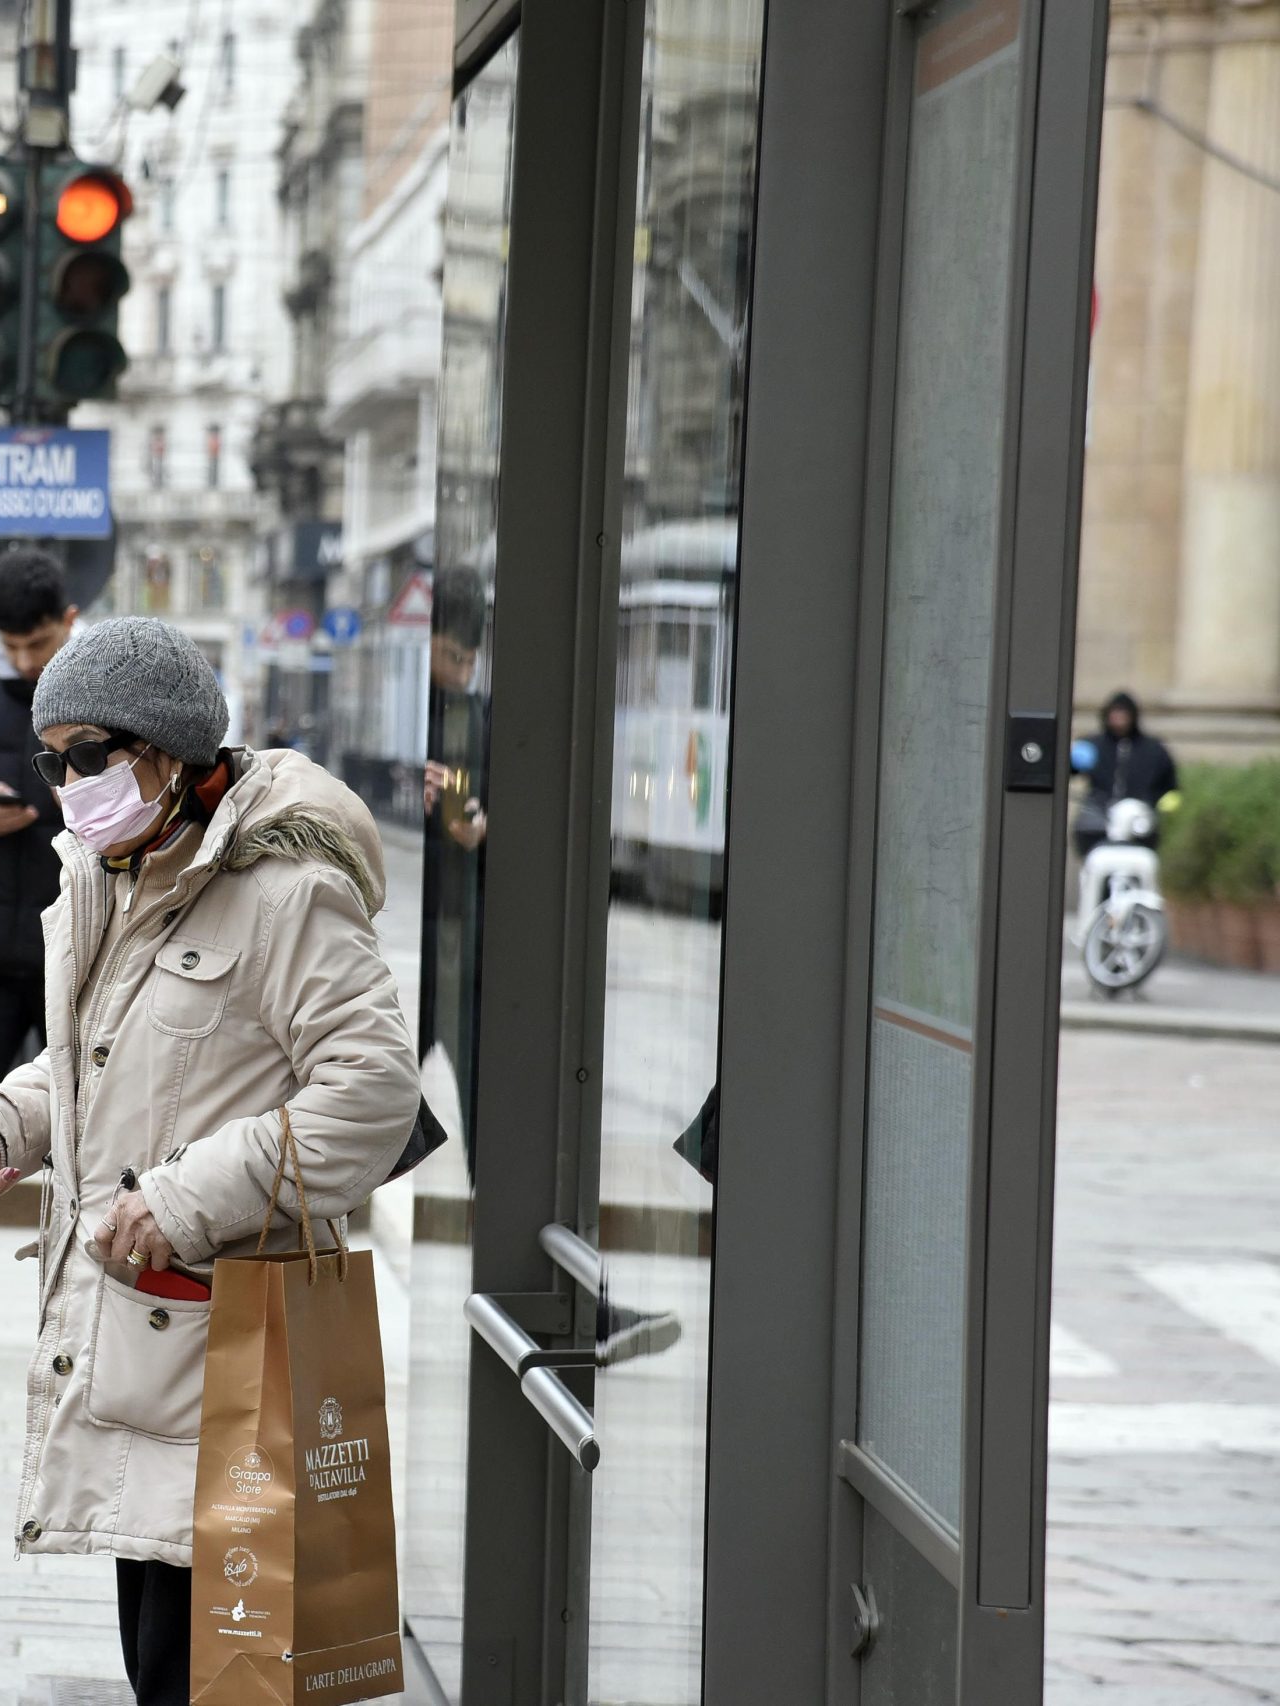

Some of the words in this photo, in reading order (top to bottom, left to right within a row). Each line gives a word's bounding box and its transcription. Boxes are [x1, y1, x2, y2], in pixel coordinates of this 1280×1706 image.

[305, 1438, 370, 1472] MAZZETTI
[229, 1466, 271, 1484] Grappa
[309, 1465, 366, 1490] D'ALTAVILLA
[235, 1481, 262, 1495] Store
[231, 1526, 252, 1534] MILANO
[223, 1558, 247, 1577] 1846
[306, 1671, 335, 1692] L'ARTE
[337, 1665, 364, 1685] DELLA
[365, 1657, 397, 1678] GRAPPA
